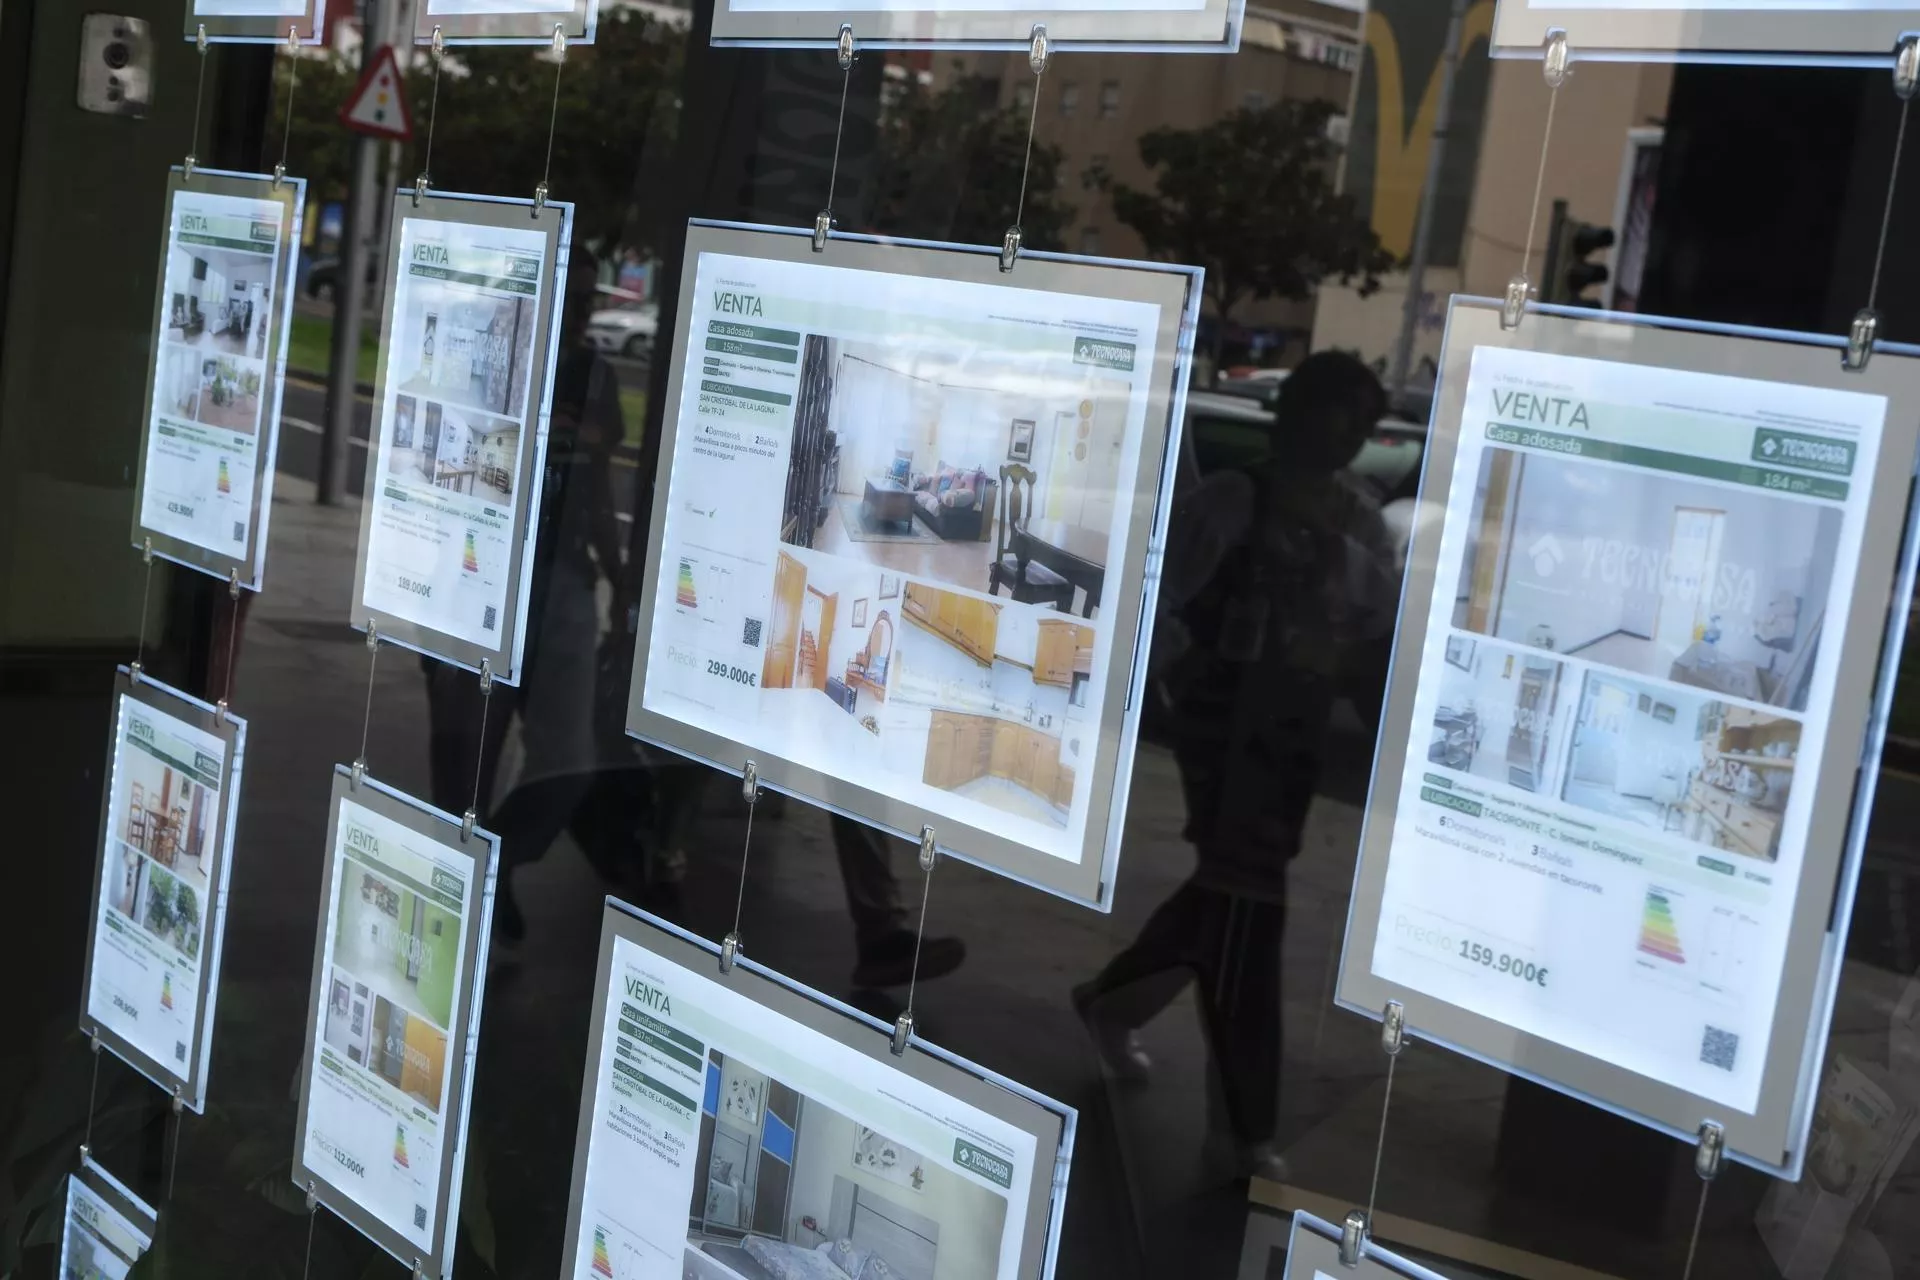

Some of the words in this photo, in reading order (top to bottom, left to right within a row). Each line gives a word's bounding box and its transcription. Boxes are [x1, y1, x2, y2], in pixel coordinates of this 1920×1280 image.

[412, 243, 449, 265] VENTA
[714, 291, 763, 317] VENTA
[708, 321, 725, 334] Casa
[726, 325, 755, 338] adosada
[1492, 388, 1590, 431] VENTA
[1486, 423, 1519, 442] Casa
[1521, 431, 1582, 454] adosada
[707, 659, 757, 687] 299.000€
[1483, 807, 1541, 833] TACORONTE
[346, 823, 379, 857] VENTA
[1458, 939, 1549, 988] 159.900€
[625, 975, 671, 1017] VENTA
[622, 1004, 637, 1019] Casa
[636, 1013, 672, 1037] unifamiliar
[334, 1147, 365, 1178] 112.000€
